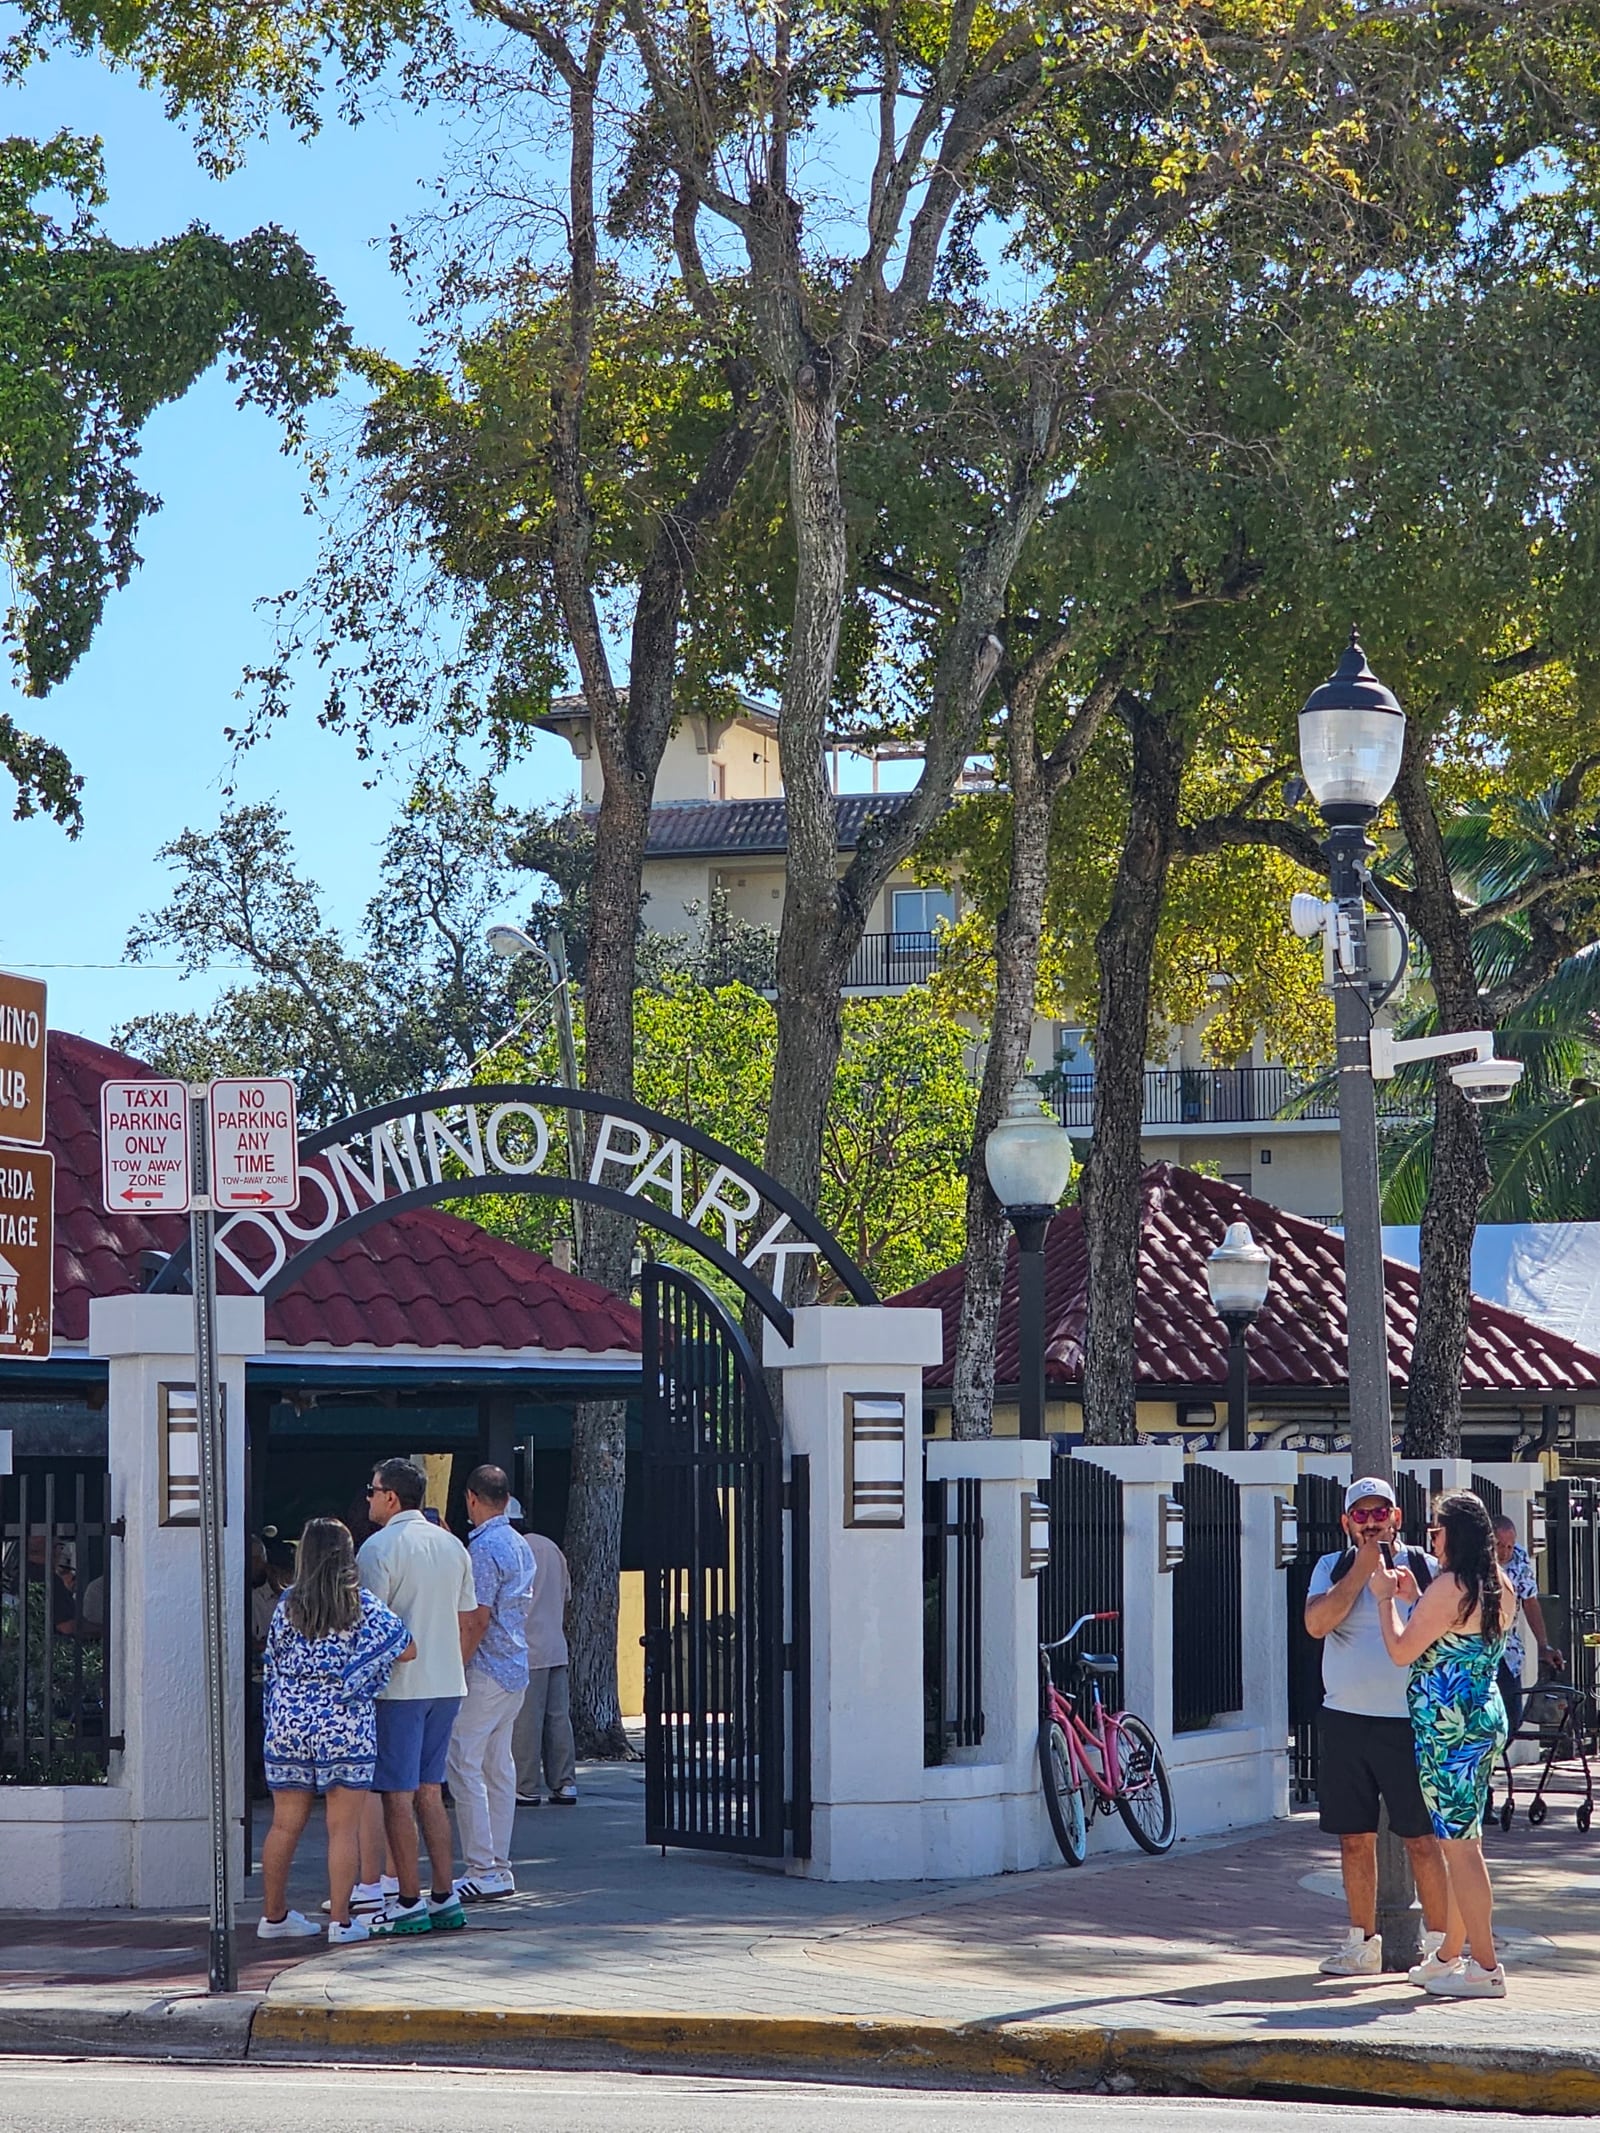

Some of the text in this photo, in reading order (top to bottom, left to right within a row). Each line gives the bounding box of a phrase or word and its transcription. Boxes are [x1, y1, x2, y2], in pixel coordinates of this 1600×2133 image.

[122, 1089, 168, 1108] TAXI
[239, 1089, 265, 1109] NO
[110, 1112, 182, 1131] PARKING
[218, 1111, 288, 1129] PARKING
[125, 1136, 167, 1154] ONLY
[237, 1132, 270, 1151] ANY
[111, 1160, 182, 1172] TOW AWAY
[233, 1154, 275, 1173] TIME
[128, 1174, 166, 1186] ZONE
[222, 1175, 289, 1185] TOW-AWAY ZONE
[213, 1101, 822, 1301] DOMINO PARK
